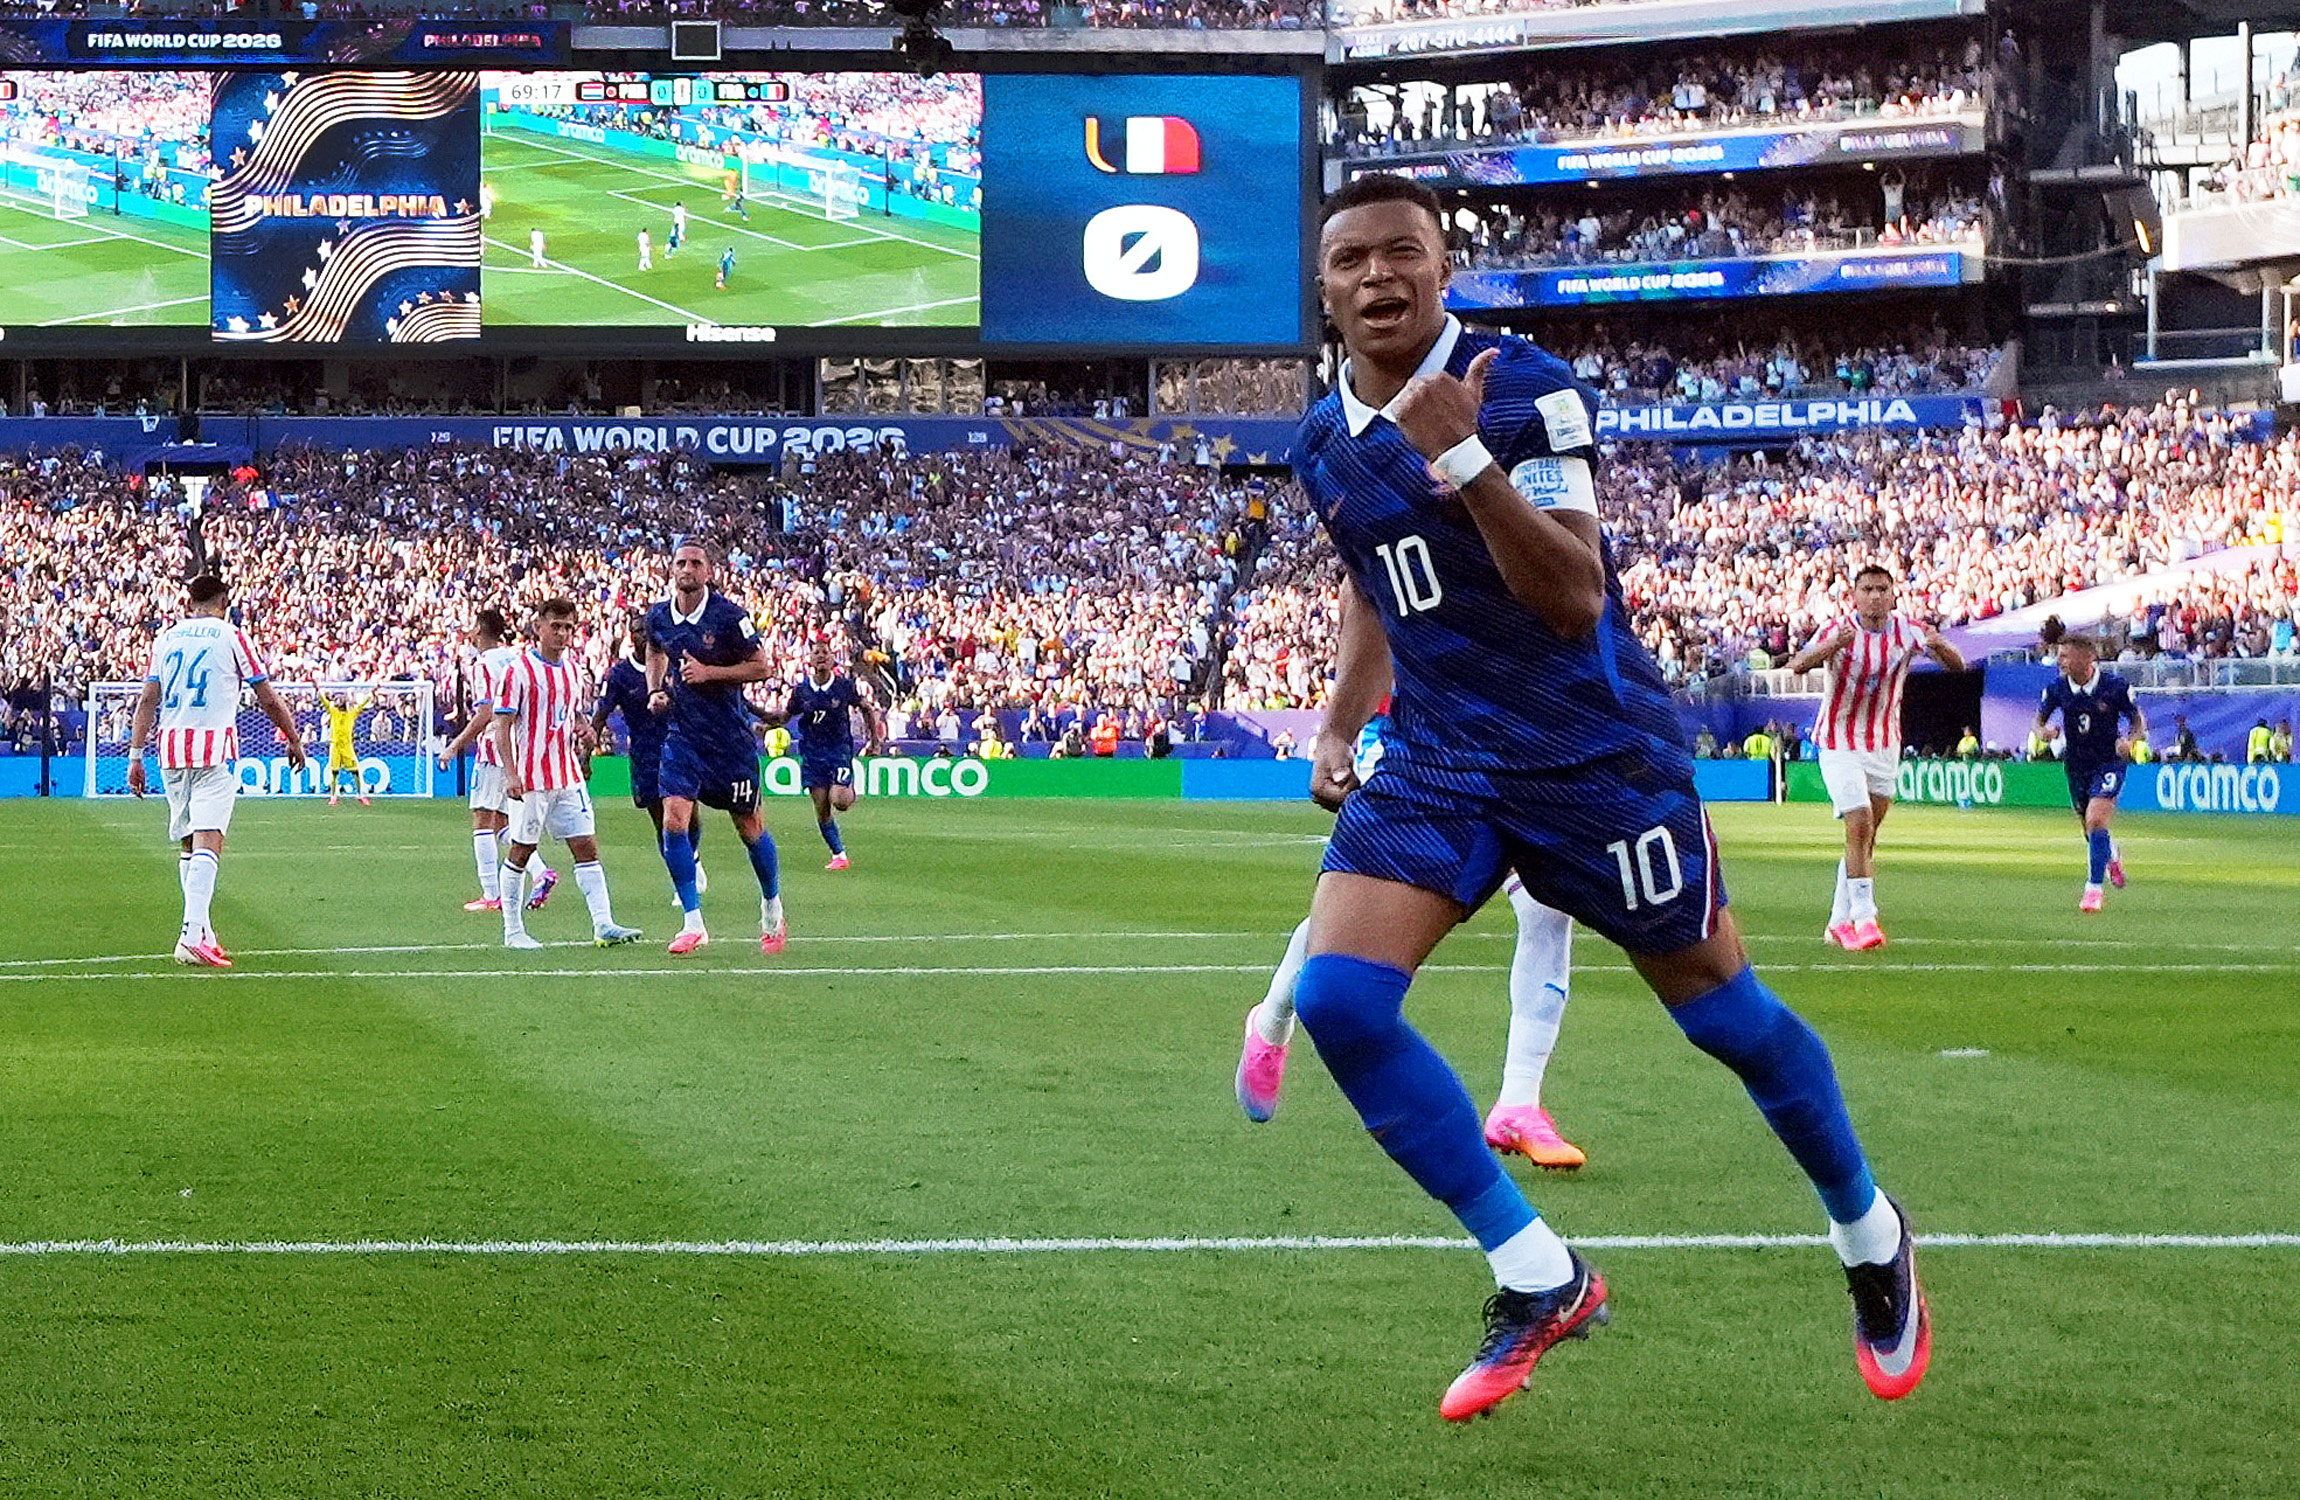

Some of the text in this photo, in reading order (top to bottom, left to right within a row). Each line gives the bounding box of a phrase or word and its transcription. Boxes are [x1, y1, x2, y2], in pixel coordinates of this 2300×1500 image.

[87, 33, 282, 48] FIFA WORLD CUP 2026
[511, 84, 562, 99] 69:17
[1557, 154, 1589, 170] FIFA
[1588, 151, 1641, 168] WORLD
[1641, 149, 1671, 164] CUP
[244, 194, 447, 218] PHILADELPHIA
[1557, 271, 1725, 294] FIFA WORLD CUP 2026
[686, 323, 776, 342] Hisense
[1595, 399, 1917, 432] PHILADELPHIA
[493, 426, 906, 454] FIFA WORLD CUP 2026
[1376, 534, 1442, 617] 10
[165, 646, 211, 708] 24
[813, 710, 826, 724] 17
[234, 757, 391, 794] amco
[764, 757, 988, 797] amco
[836, 767, 850, 783] 17
[1898, 761, 2002, 803] aramco
[2156, 764, 2280, 812] aramco
[731, 779, 753, 803] 14
[1606, 825, 1683, 911] 10
